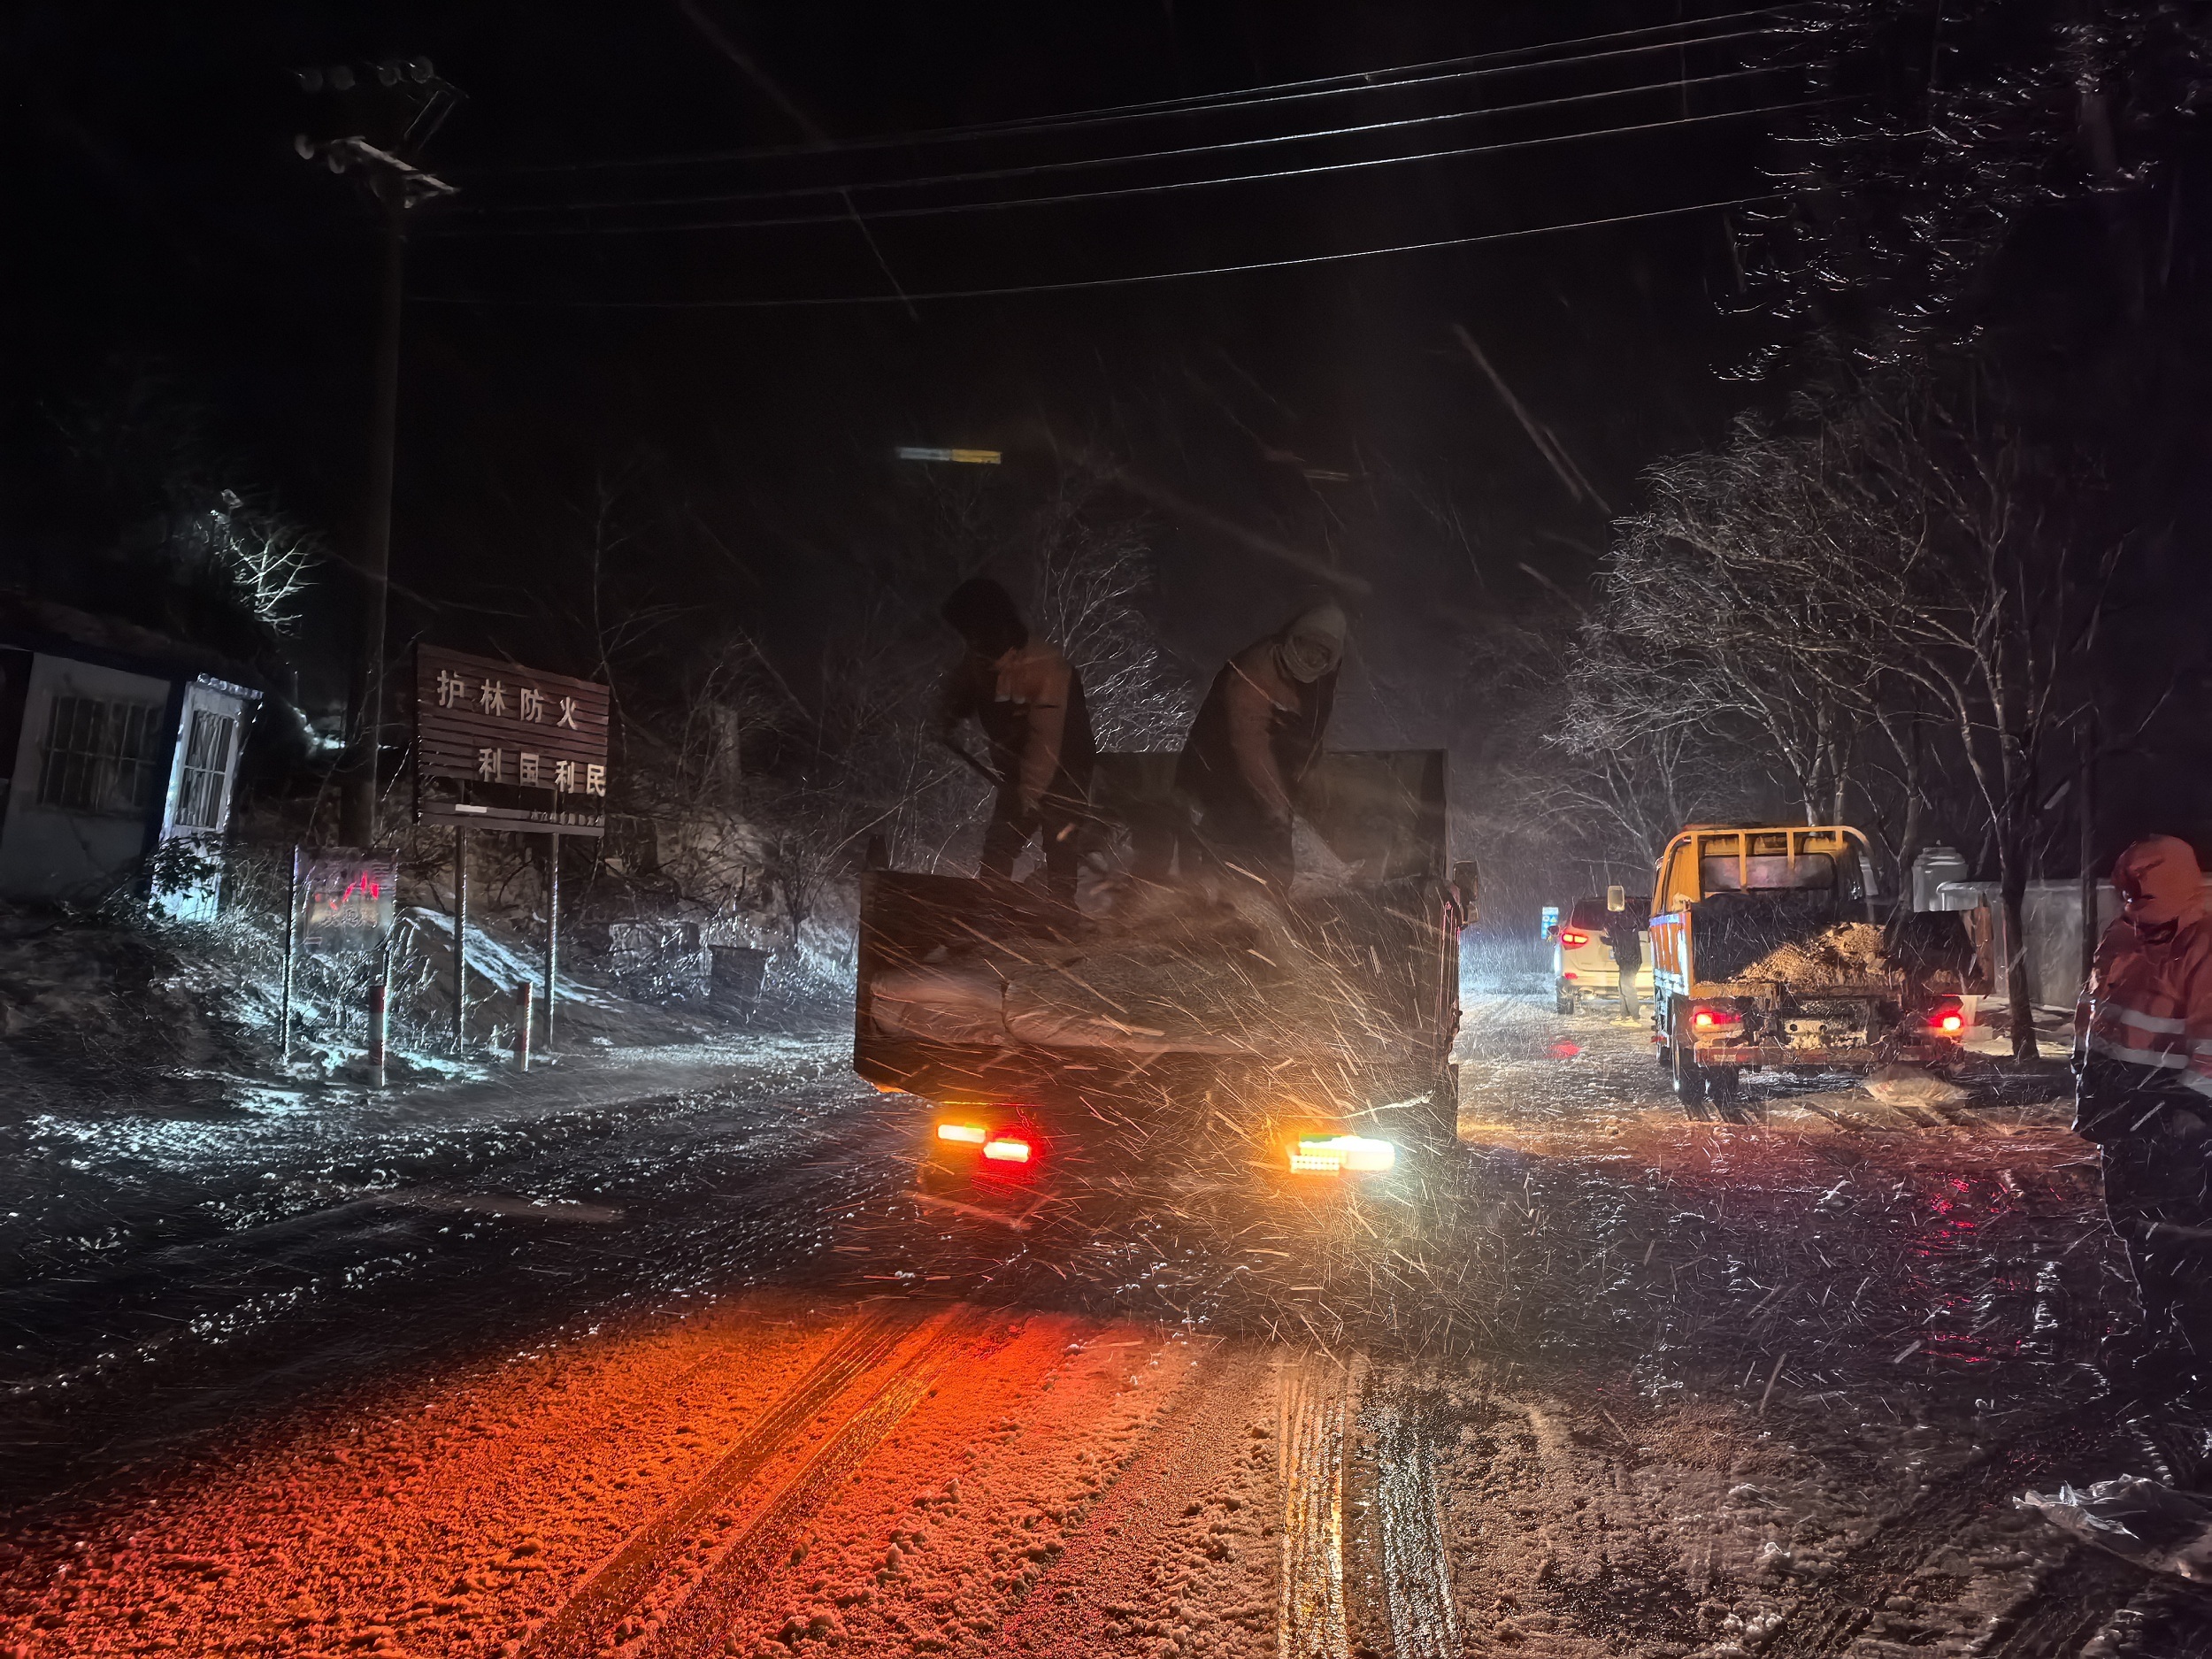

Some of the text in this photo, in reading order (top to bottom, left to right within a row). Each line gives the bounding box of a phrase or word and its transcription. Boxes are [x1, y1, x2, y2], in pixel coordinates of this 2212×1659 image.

[436, 670, 578, 730] 护林防火
[479, 748, 607, 797] 利国利民
